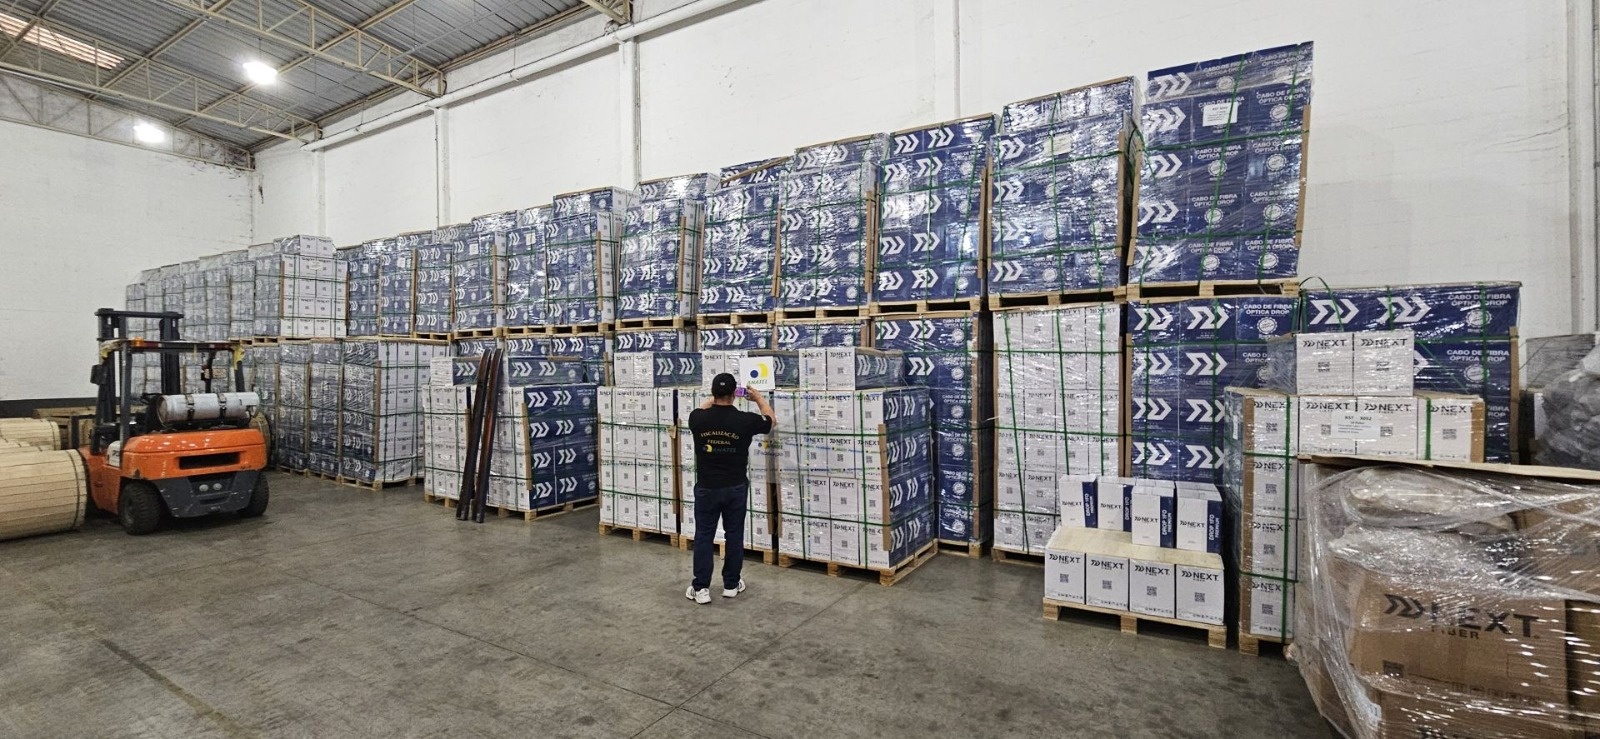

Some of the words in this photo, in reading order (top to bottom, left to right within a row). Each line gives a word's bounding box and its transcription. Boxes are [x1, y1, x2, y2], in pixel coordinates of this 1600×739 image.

[1316, 339, 1348, 347] NEXT
[1320, 402, 1350, 410] NEXT
[1379, 403, 1411, 412] NEXT
[1059, 555, 1080, 563] NEXT
[1101, 561, 1124, 569] NEXT
[1145, 566, 1170, 575] NEXT
[1193, 572, 1219, 581] NEXT
